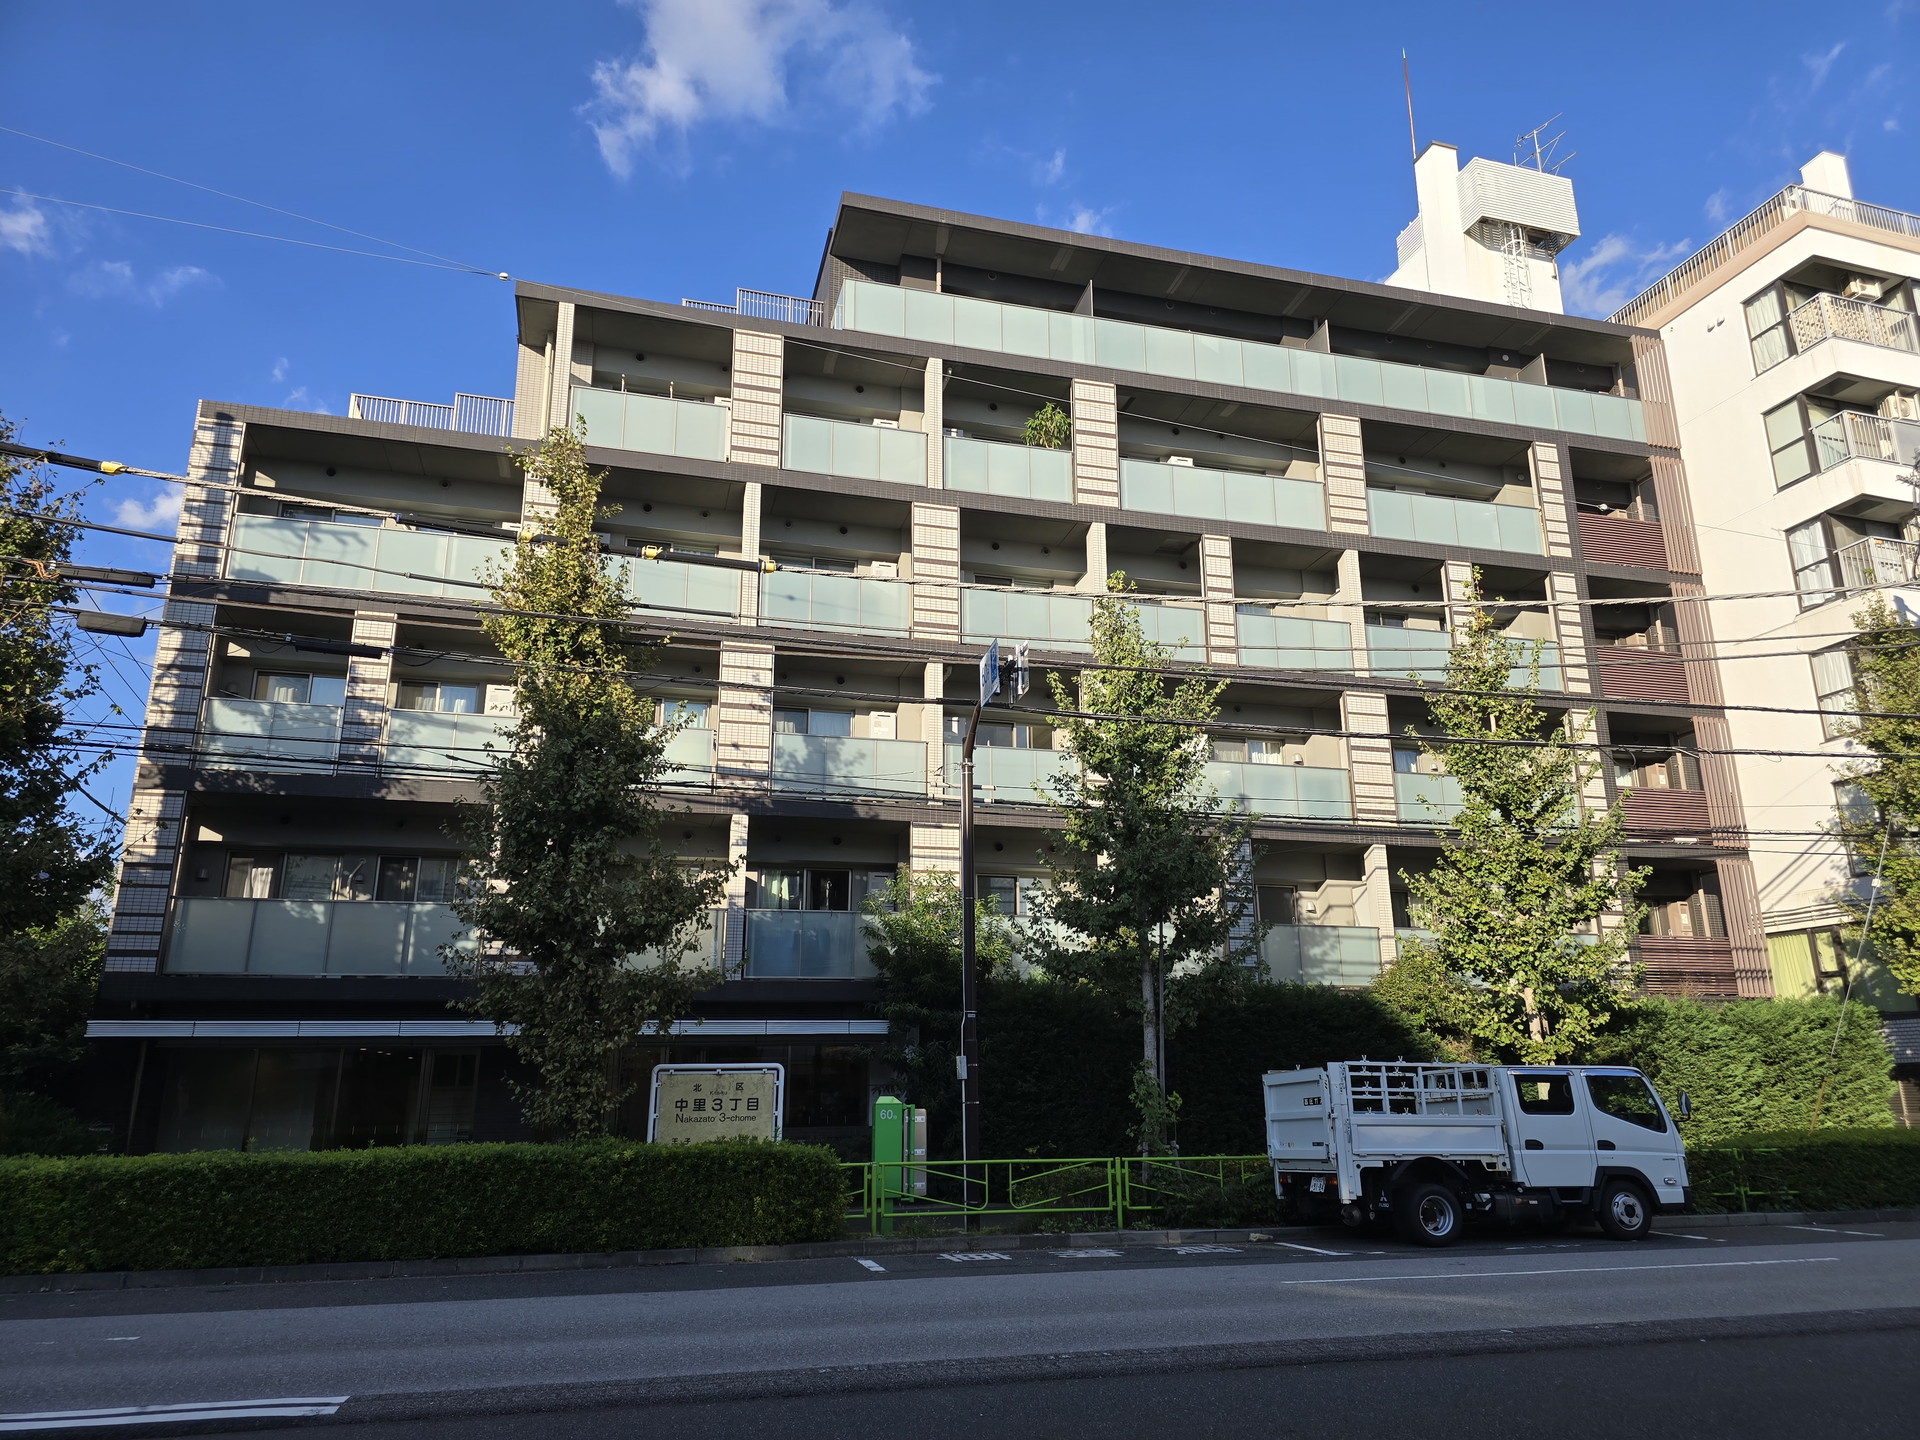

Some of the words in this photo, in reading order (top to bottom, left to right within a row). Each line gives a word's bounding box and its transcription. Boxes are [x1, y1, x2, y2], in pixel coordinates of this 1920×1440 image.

[693, 1083, 702, 1092] 北
[736, 1082, 744, 1091] 区
[675, 1097, 759, 1112] 中里3丁目
[675, 1113, 716, 1123] Nakazato
[719, 1112, 757, 1122] 3-chome
